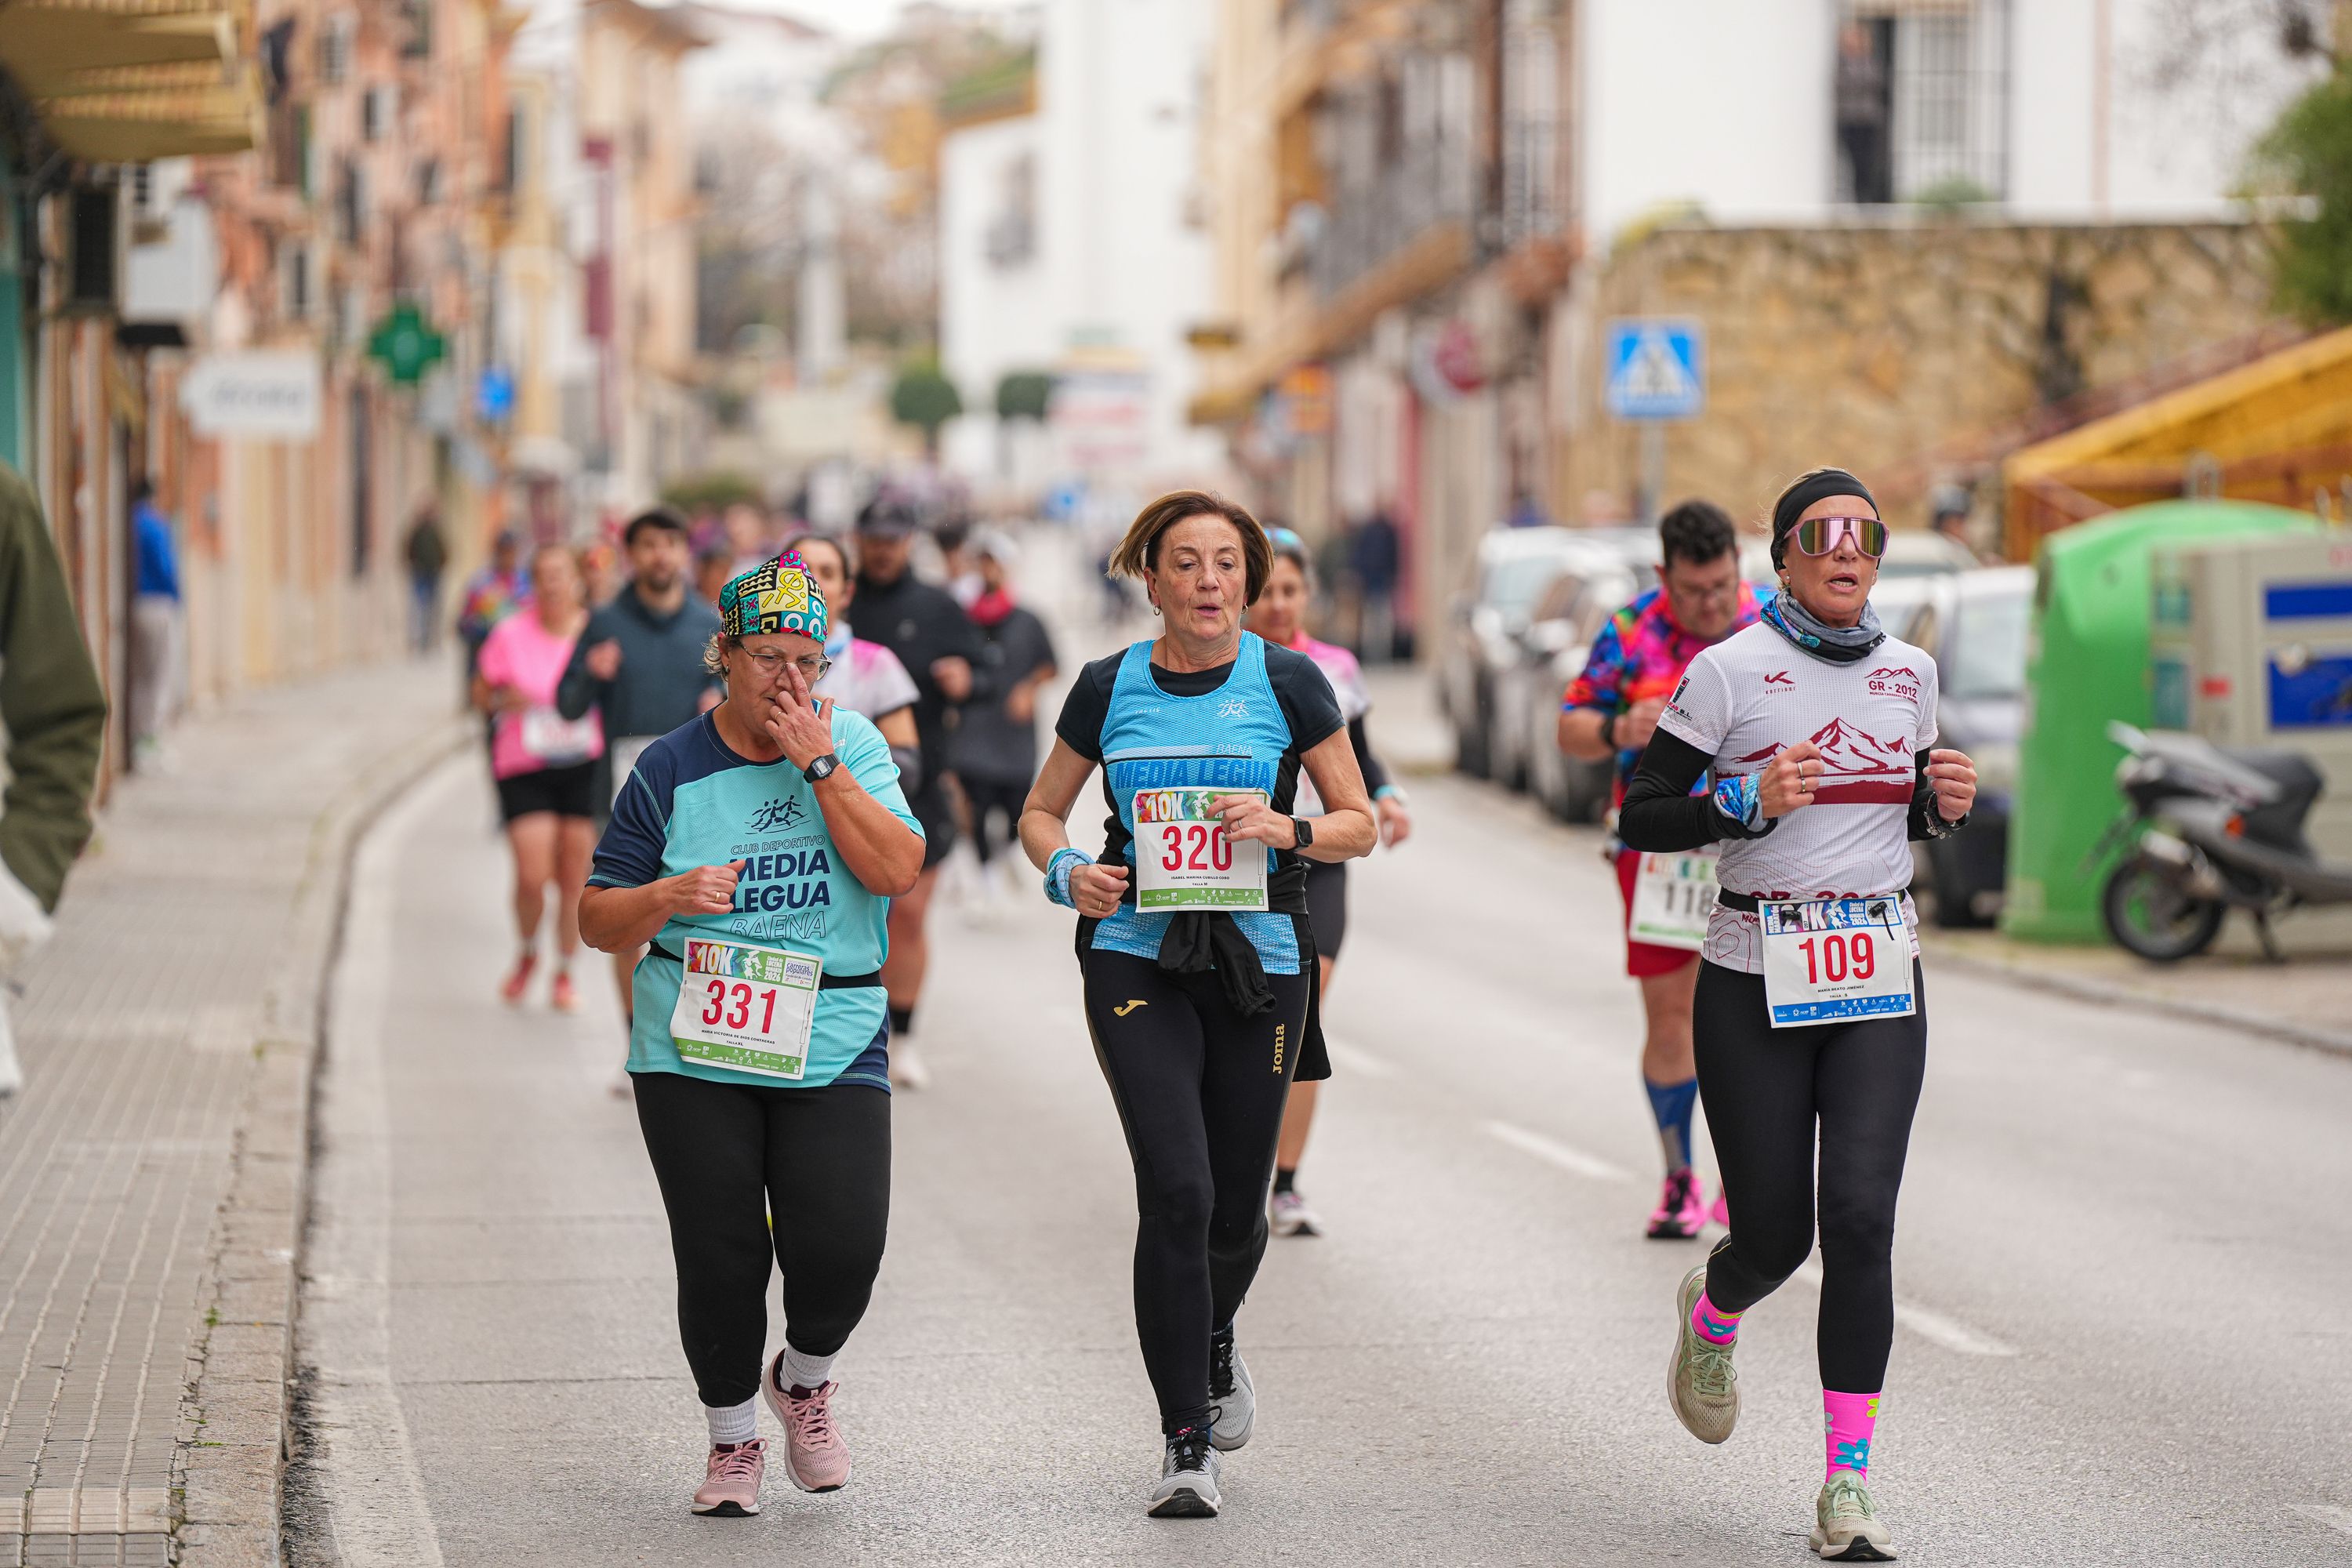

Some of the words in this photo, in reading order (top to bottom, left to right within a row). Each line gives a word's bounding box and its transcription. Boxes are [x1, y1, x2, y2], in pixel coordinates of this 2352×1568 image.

[1868, 680, 1886, 691] GR
[1895, 683, 1918, 699] 2012
[1116, 760, 1189, 789] MEDIA
[1197, 759, 1271, 789] LEGUA
[1145, 793, 1185, 822] 10K
[731, 843, 759, 855] CLUB
[761, 835, 826, 852] DEPORTIVO
[1162, 825, 1232, 871] 320
[730, 849, 831, 883] MEDIA
[730, 881, 831, 914] LEGUA
[730, 911, 826, 941] BAENA
[1781, 902, 1828, 932] 21K
[1851, 917, 1868, 926] 2026
[697, 945, 735, 975] 10K
[767, 960, 783, 968] LUCENA
[786, 963, 810, 971] carreras
[786, 967, 814, 977] populares
[1798, 932, 1875, 984] 109
[764, 971, 781, 982] 2026
[702, 979, 777, 1034] 331
[1272, 1023, 1285, 1074] joma
